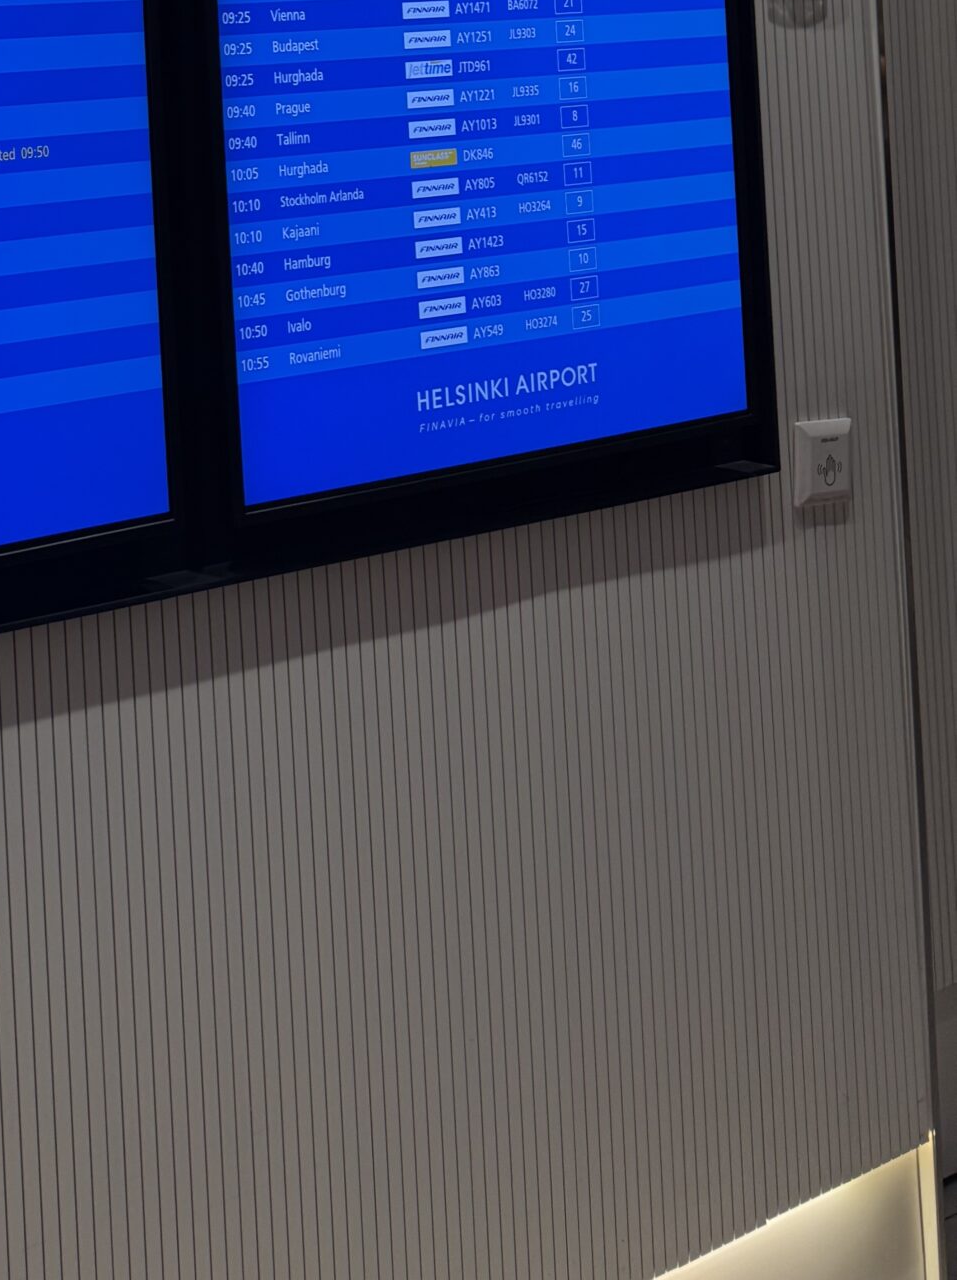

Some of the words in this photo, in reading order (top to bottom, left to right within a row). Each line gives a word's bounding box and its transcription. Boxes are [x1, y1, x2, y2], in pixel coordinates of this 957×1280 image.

[225, 73, 254, 88] 09:25
[273, 67, 324, 86] Hurghada
[457, 59, 491, 74] JTD961
[566, 52, 578, 65] 42
[20, 145, 50, 160] 09:50
[232, 198, 261, 213] 10:10
[279, 191, 328, 208] Stockholm
[329, 187, 365, 203] Arlanda
[415, 182, 456, 194] FINNAIR
[464, 176, 496, 192] AY805
[516, 170, 549, 186] QR6152
[573, 166, 583, 179] 11
[241, 355, 270, 372] 10:55
[289, 345, 341, 365] Rovaniemi
[424, 330, 465, 344] FINNAIR
[473, 323, 504, 340] AY549
[525, 315, 558, 330] HO3274
[581, 309, 592, 322] 25
[416, 376, 510, 412] HELSINKI
[515, 362, 598, 396] AIRPORT
[419, 417, 466, 433] FINAVIA
[479, 413, 495, 422] for
[500, 404, 541, 419] smooth
[545, 394, 599, 411] travelling
